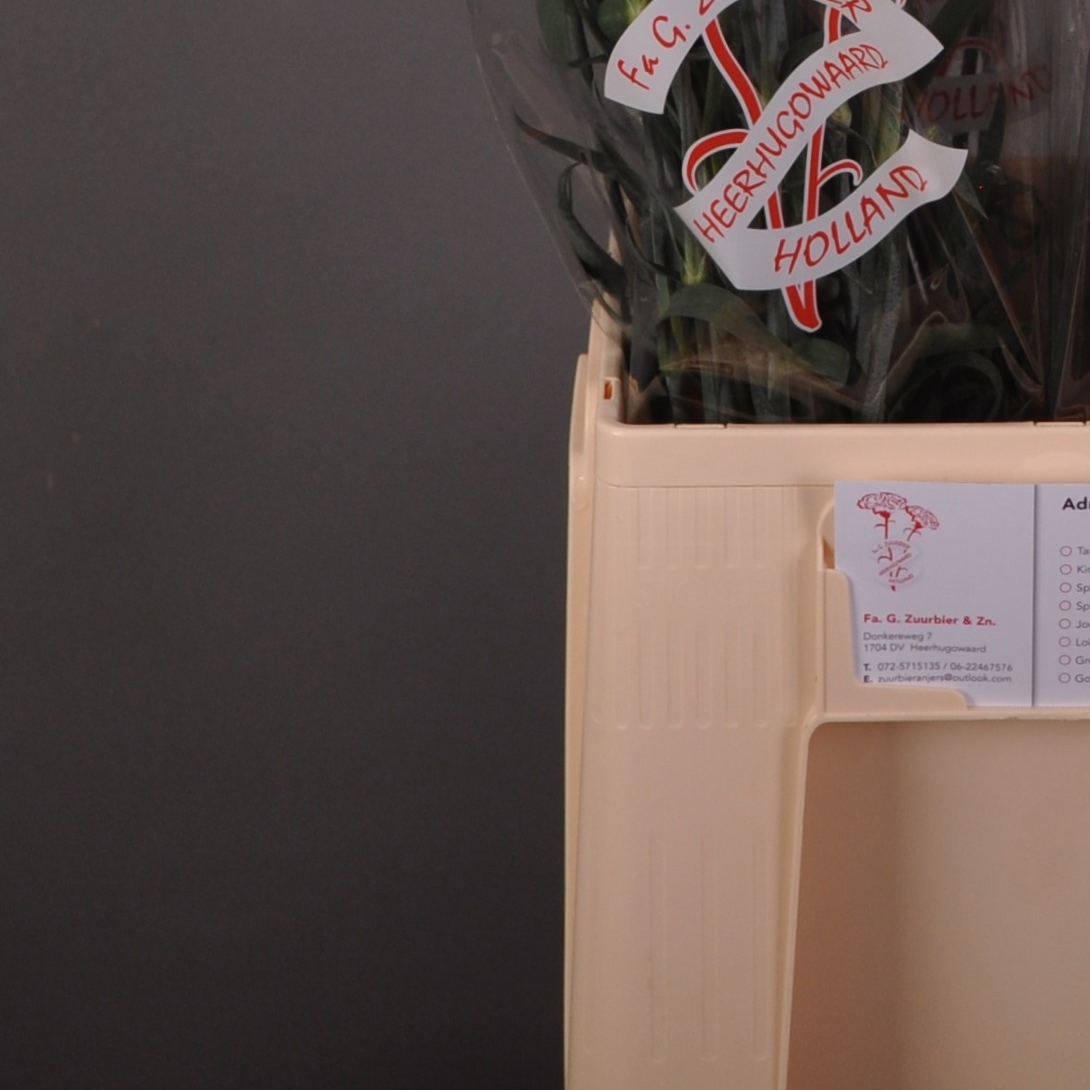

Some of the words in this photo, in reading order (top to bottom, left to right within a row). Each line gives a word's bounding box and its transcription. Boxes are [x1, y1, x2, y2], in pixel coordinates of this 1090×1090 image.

[617, 55, 660, 90] Fa
[652, 15, 691, 48] G.
[693, 44, 888, 243] HEERHUGOWAARD
[774, 165, 928, 274] HOLLAND
[864, 614, 882, 623] Fa.
[887, 614, 900, 623] G.
[905, 615, 958, 625] Zuurbier
[963, 616, 972, 625] &
[977, 616, 996, 626] Zn.
[864, 632, 924, 641] Donkereweg
[927, 632, 932, 640] 7
[864, 644, 887, 652] 1704
[890, 644, 904, 652] DV
[910, 644, 986, 654] Heerhugowaard
[878, 663, 940, 671] 072-5715135
[863, 675, 873, 683] E.
